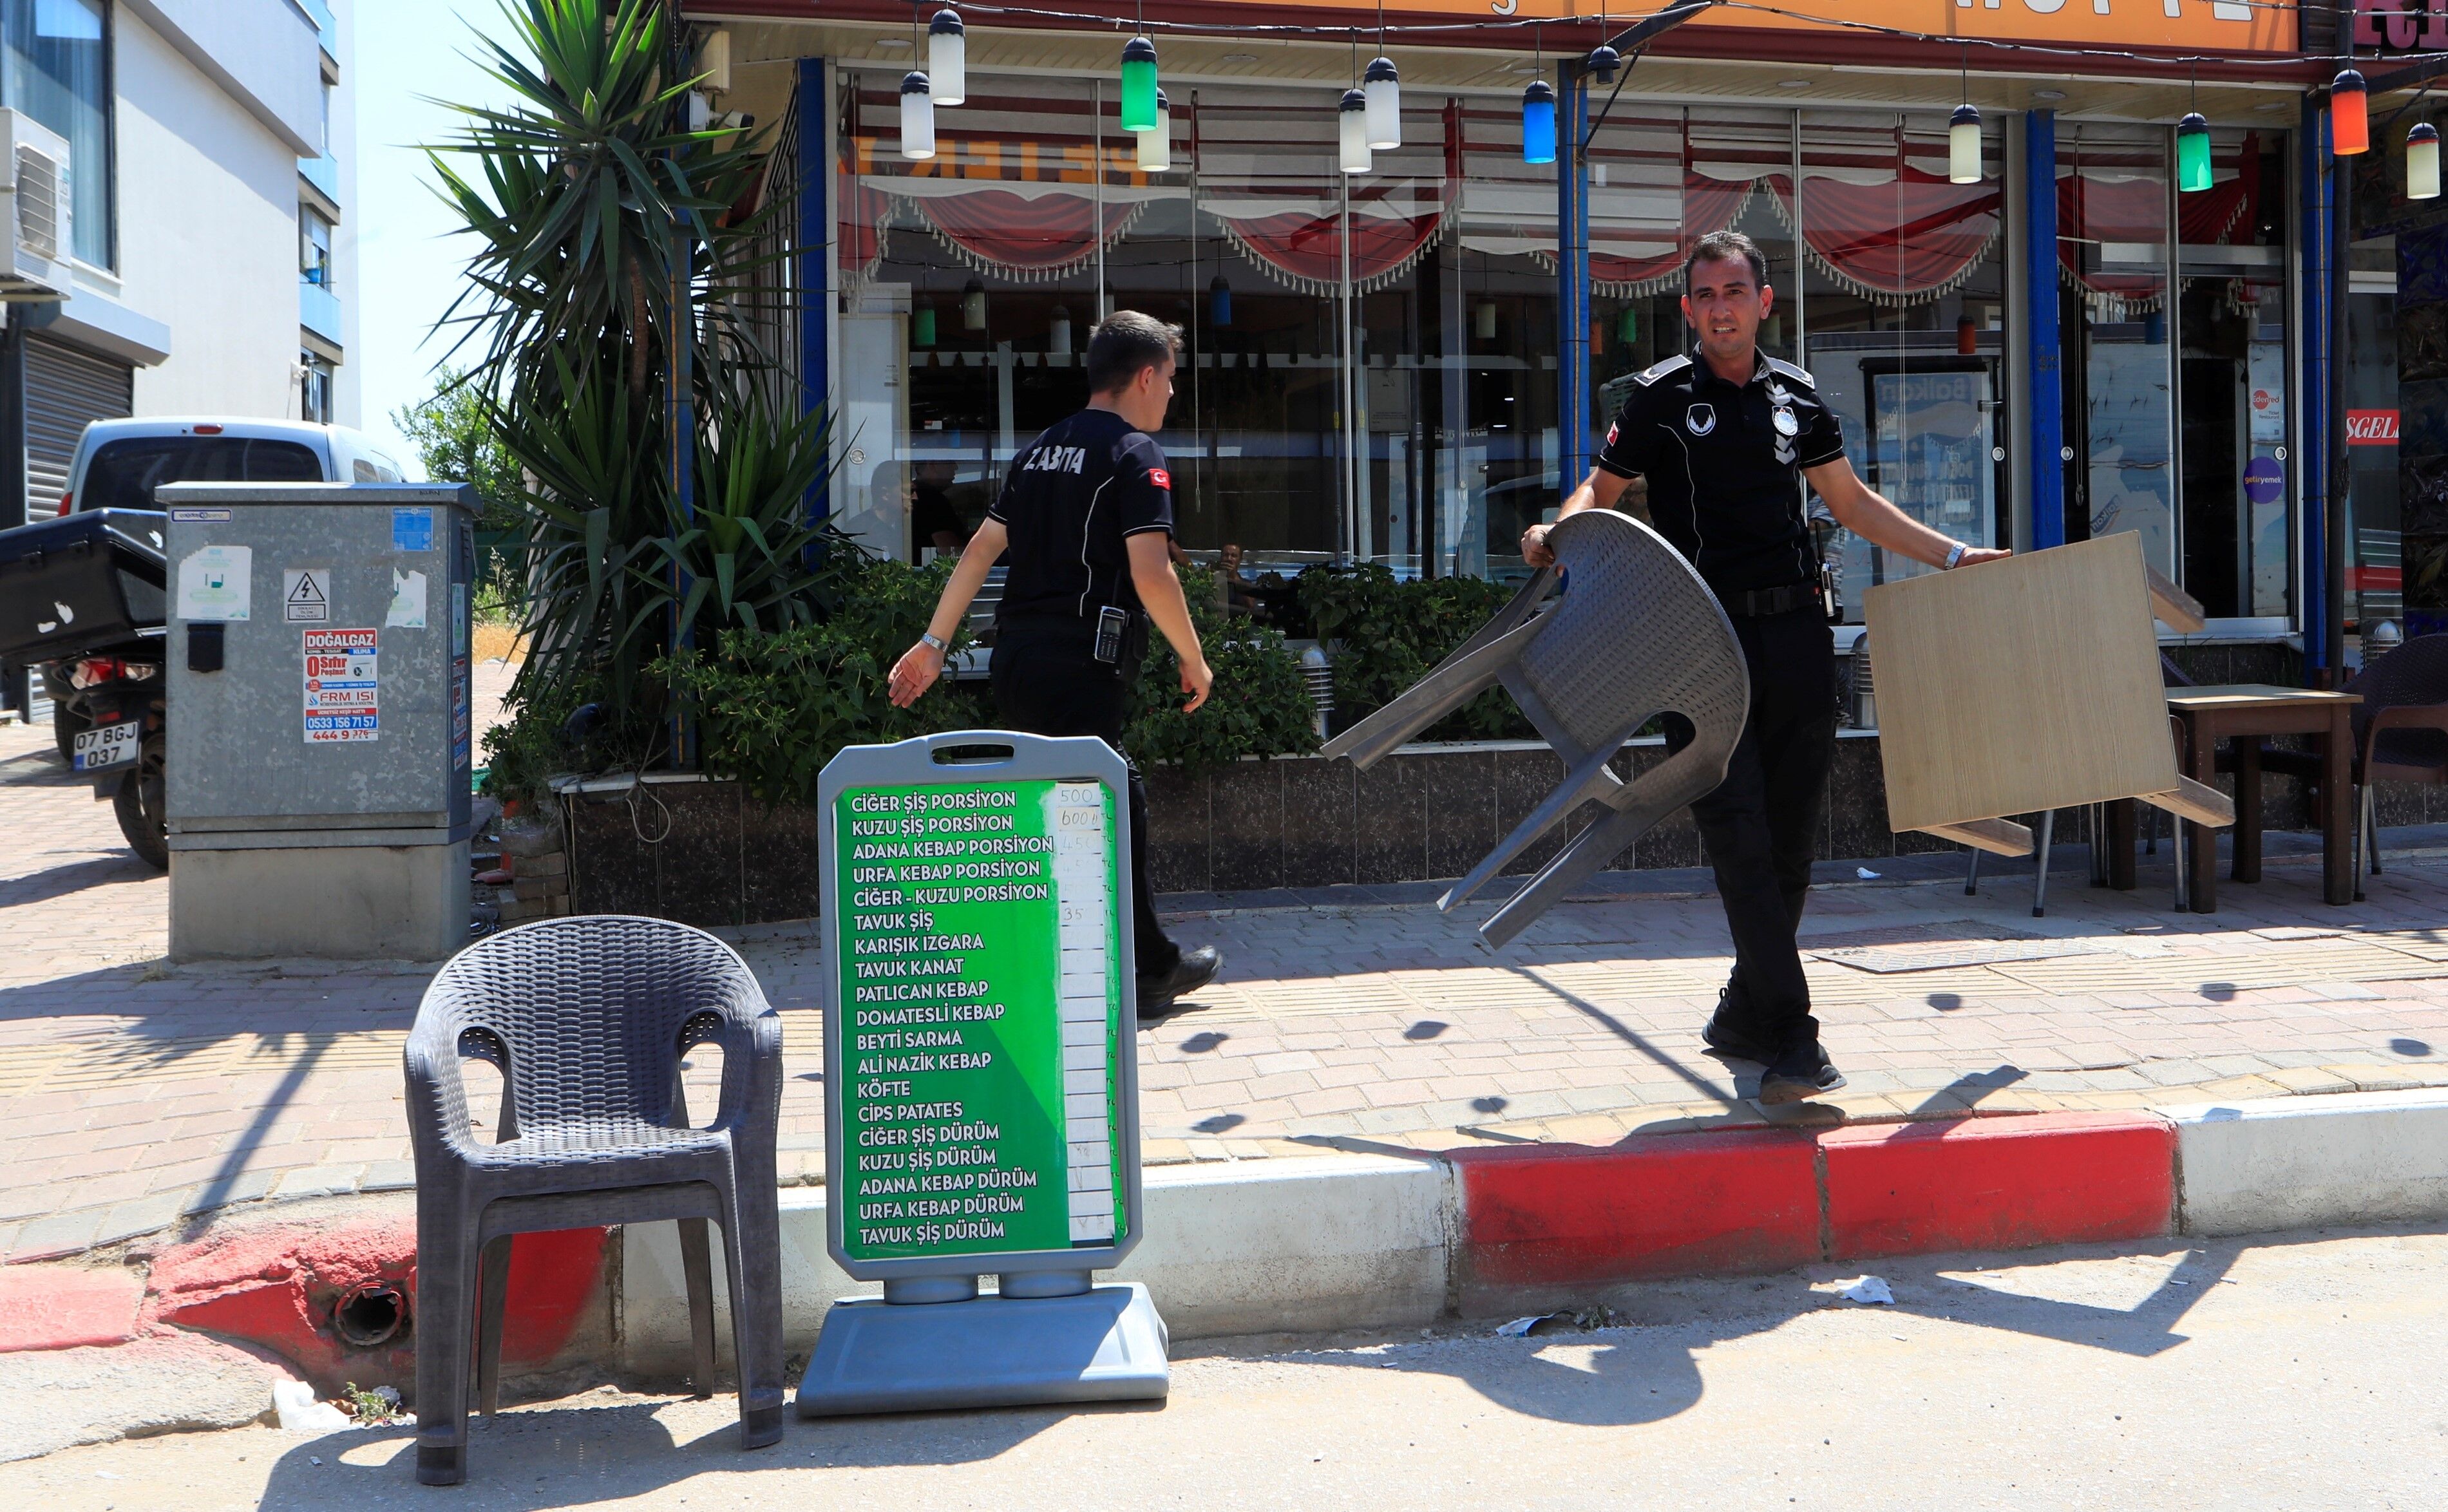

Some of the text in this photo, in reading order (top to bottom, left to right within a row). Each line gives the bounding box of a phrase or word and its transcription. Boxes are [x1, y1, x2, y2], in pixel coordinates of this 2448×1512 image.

[2244, 477, 2281, 485] getiryemek
[307, 632, 374, 647] DOĞALGAZ
[307, 656, 319, 677] 0
[320, 691, 374, 701] FRM ISI
[308, 716, 375, 729] 0533 156 71 57
[76, 723, 136, 750] 07 BGJ
[313, 731, 338, 740] 444
[341, 730, 349, 739] 9
[88, 746, 120, 767] 037
[851, 788, 1016, 815] CİĞER ŞİŞ PORSİYON
[1060, 789, 1092, 803] 500
[852, 811, 1013, 838] KUZU ŞİŞ PORSİYON
[852, 833, 1054, 860] ADANA KEBAP PORSİYON
[853, 857, 1040, 884] URFA KEBAP PORSİYON
[853, 887, 903, 907] CİĞER
[915, 887, 960, 905] KUZU
[963, 880, 1048, 902] PORSİYON
[853, 908, 934, 932] TAVUK ŞİŞ
[855, 933, 985, 957] KARIŞIK IZGARA
[855, 958, 965, 979] TAVUK KANAT
[856, 980, 989, 1003] PATLICAN KEBAP
[856, 1001, 1005, 1027] DOMATESLİ KEBAP
[857, 1028, 963, 1051] BEYTİ SARMA
[857, 1051, 992, 1075] ALİ NAZİK KEBAP
[857, 1077, 911, 1099] KÖFTE
[857, 1101, 963, 1123] CİPS PATATES
[858, 1119, 1000, 1148] CİĞER ŞİŞ DÜRÜM
[859, 1144, 996, 1173] KUZU ŞİŞ DÜRÜM
[859, 1166, 1038, 1196] ADANA KEBAP DÜRÜM
[859, 1191, 1024, 1220] URFA KEBAP DÜRÜM
[859, 1217, 1005, 1246] TAVUK ŞİŞ DÜRÜM
